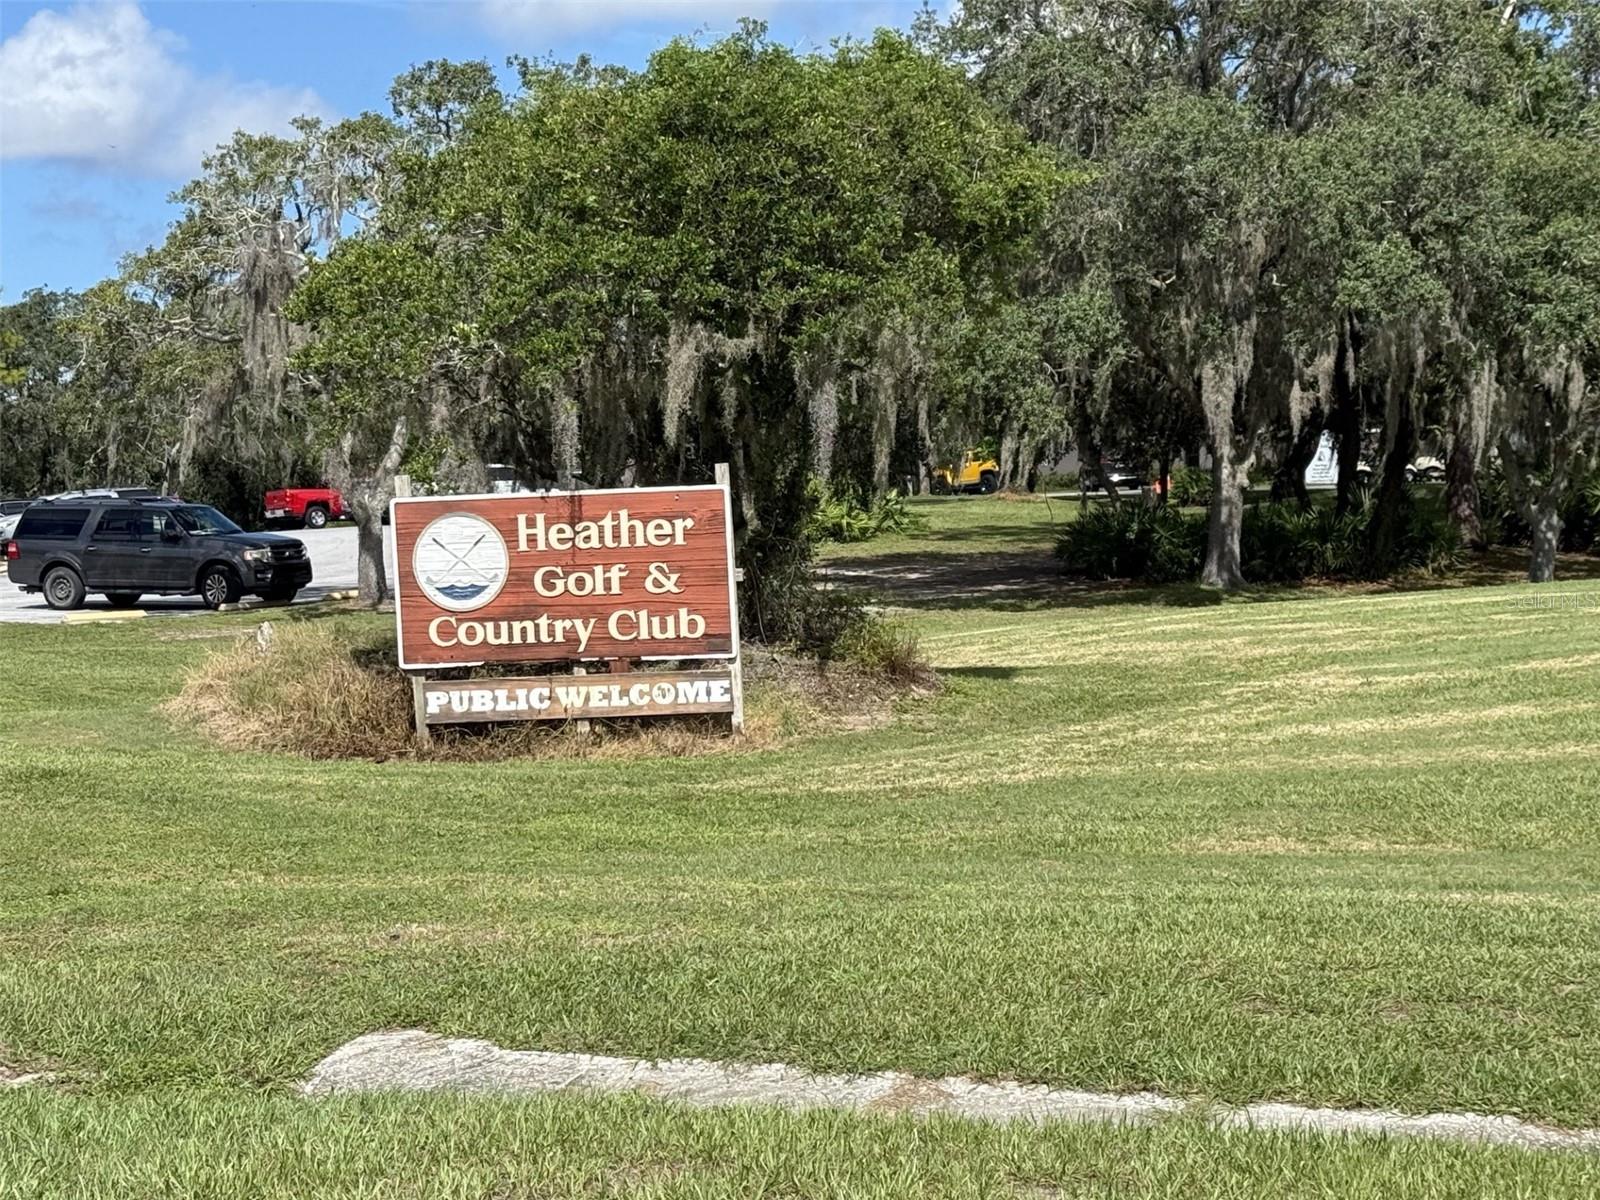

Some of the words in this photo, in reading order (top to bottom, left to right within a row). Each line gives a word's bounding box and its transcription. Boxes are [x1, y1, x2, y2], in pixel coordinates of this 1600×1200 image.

[516, 508, 695, 552] Heather
[533, 563, 629, 598] Golf
[644, 562, 684, 594] &
[428, 611, 597, 653] Country
[607, 607, 706, 641] Club
[425, 687, 552, 714] PUBLIC
[555, 680, 731, 709] WELCOME
